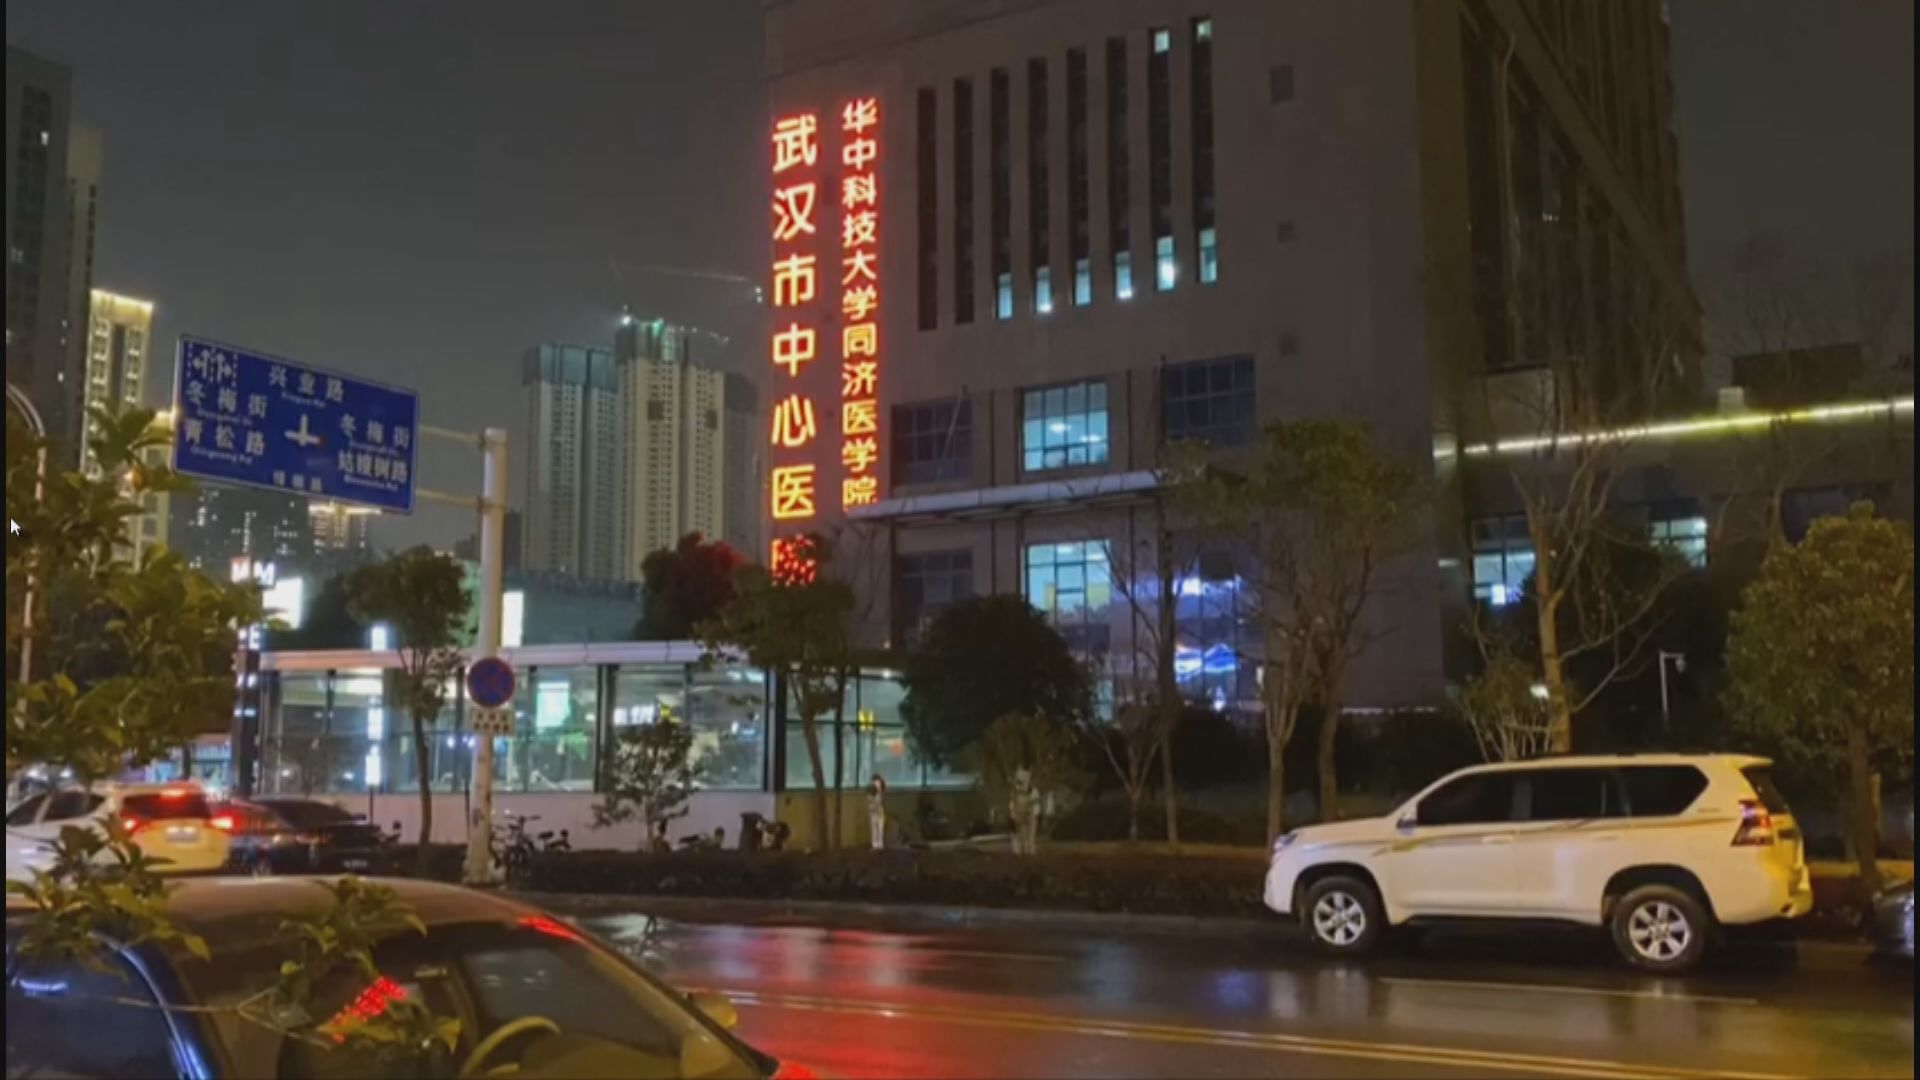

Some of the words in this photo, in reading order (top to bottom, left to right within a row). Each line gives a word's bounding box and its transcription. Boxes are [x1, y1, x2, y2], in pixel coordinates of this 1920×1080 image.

[268, 363, 344, 403] 兴业路
[841, 97, 878, 513] 华中科技大学同济医学院
